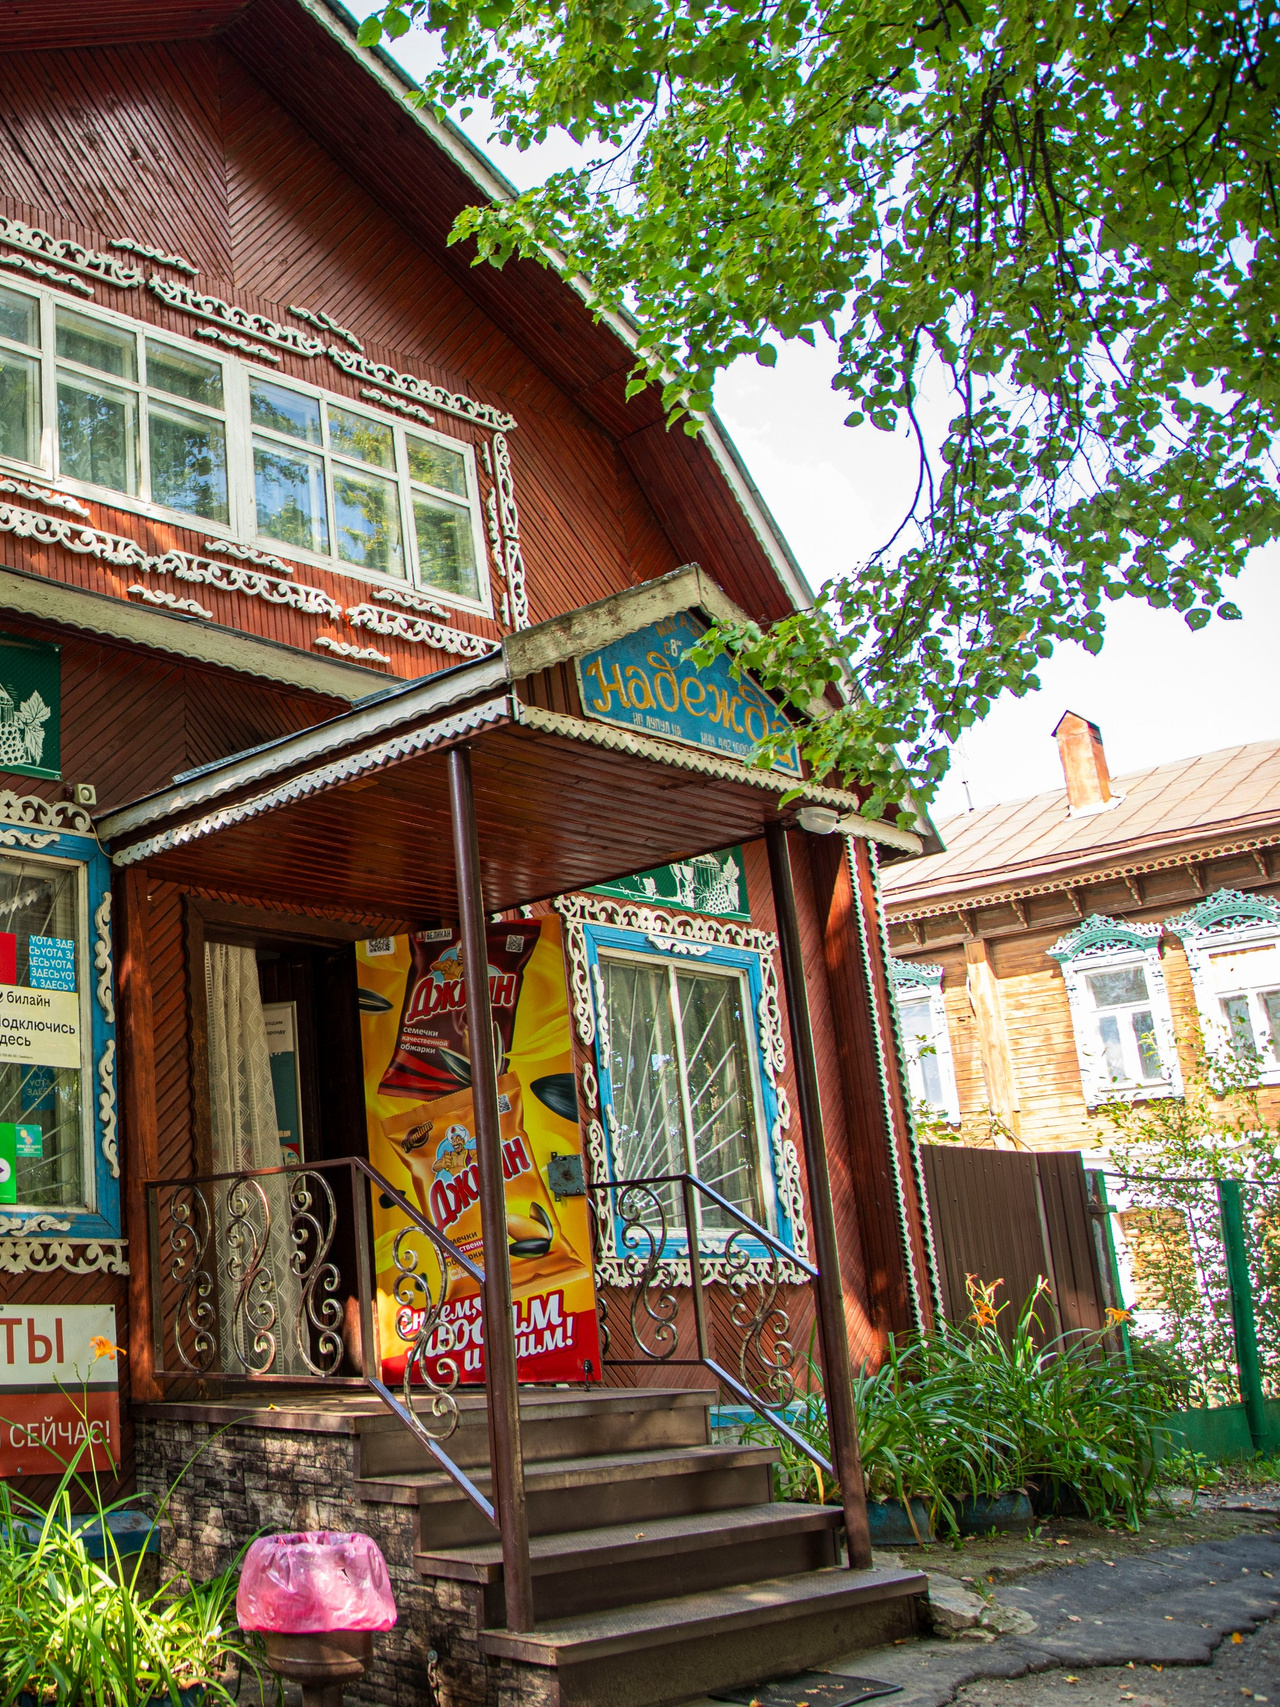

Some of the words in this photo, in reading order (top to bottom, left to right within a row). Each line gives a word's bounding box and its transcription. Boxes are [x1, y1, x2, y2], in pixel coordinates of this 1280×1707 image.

[30, 935, 53, 946] YOTA
[55, 938, 75, 949] ЗДЕ
[41, 947, 63, 958] YOTA
[50, 959, 73, 970] YOTA
[31, 967, 60, 979] ЗДЕСЬ
[40, 979, 69, 991] ЗДЕСЬ
[6, 991, 51, 1008] билайн
[403, 1027, 439, 1037] семечки
[401, 1034, 448, 1047] качественной
[400, 1043, 436, 1054] обжарки
[9, 1416, 111, 1448] СЕЙЧАС!
